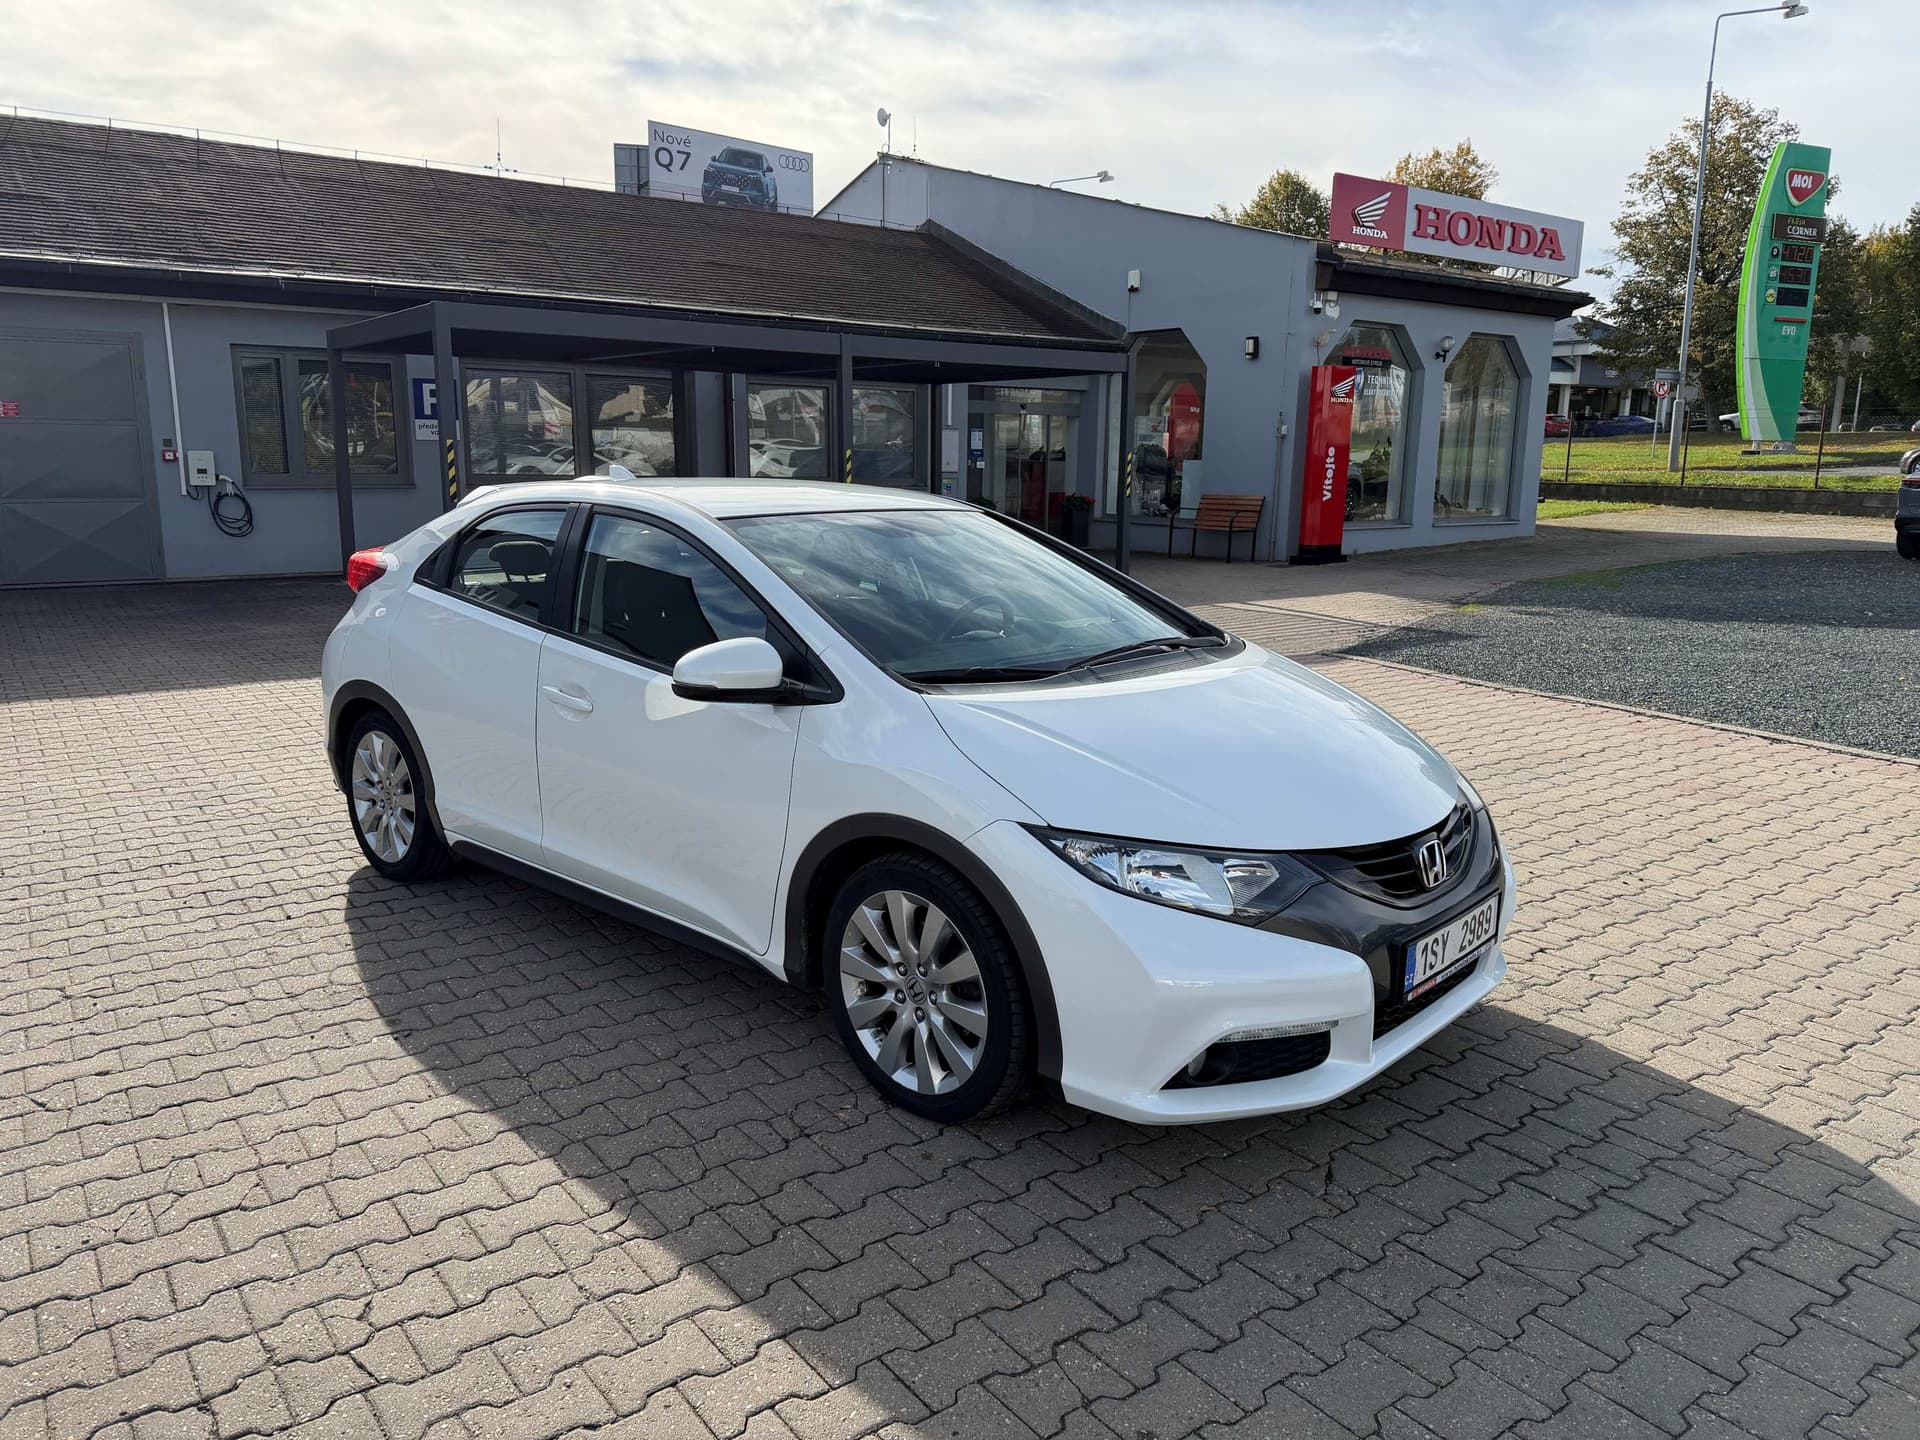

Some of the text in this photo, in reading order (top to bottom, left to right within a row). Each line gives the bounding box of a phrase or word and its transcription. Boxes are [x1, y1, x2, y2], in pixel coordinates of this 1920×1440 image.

[653, 129, 692, 147] Nové
[654, 147, 692, 173] Q7
[1791, 174, 1813, 189] MOL
[1351, 225, 1389, 240] HONDA
[1413, 203, 1566, 261] HONDA
[1787, 226, 1817, 237] CORNER
[1781, 325, 1797, 336] EVO
[1322, 446, 1336, 502] Vítejte
[1421, 930, 1449, 975] 1SY
[1459, 904, 1492, 953] 2989
